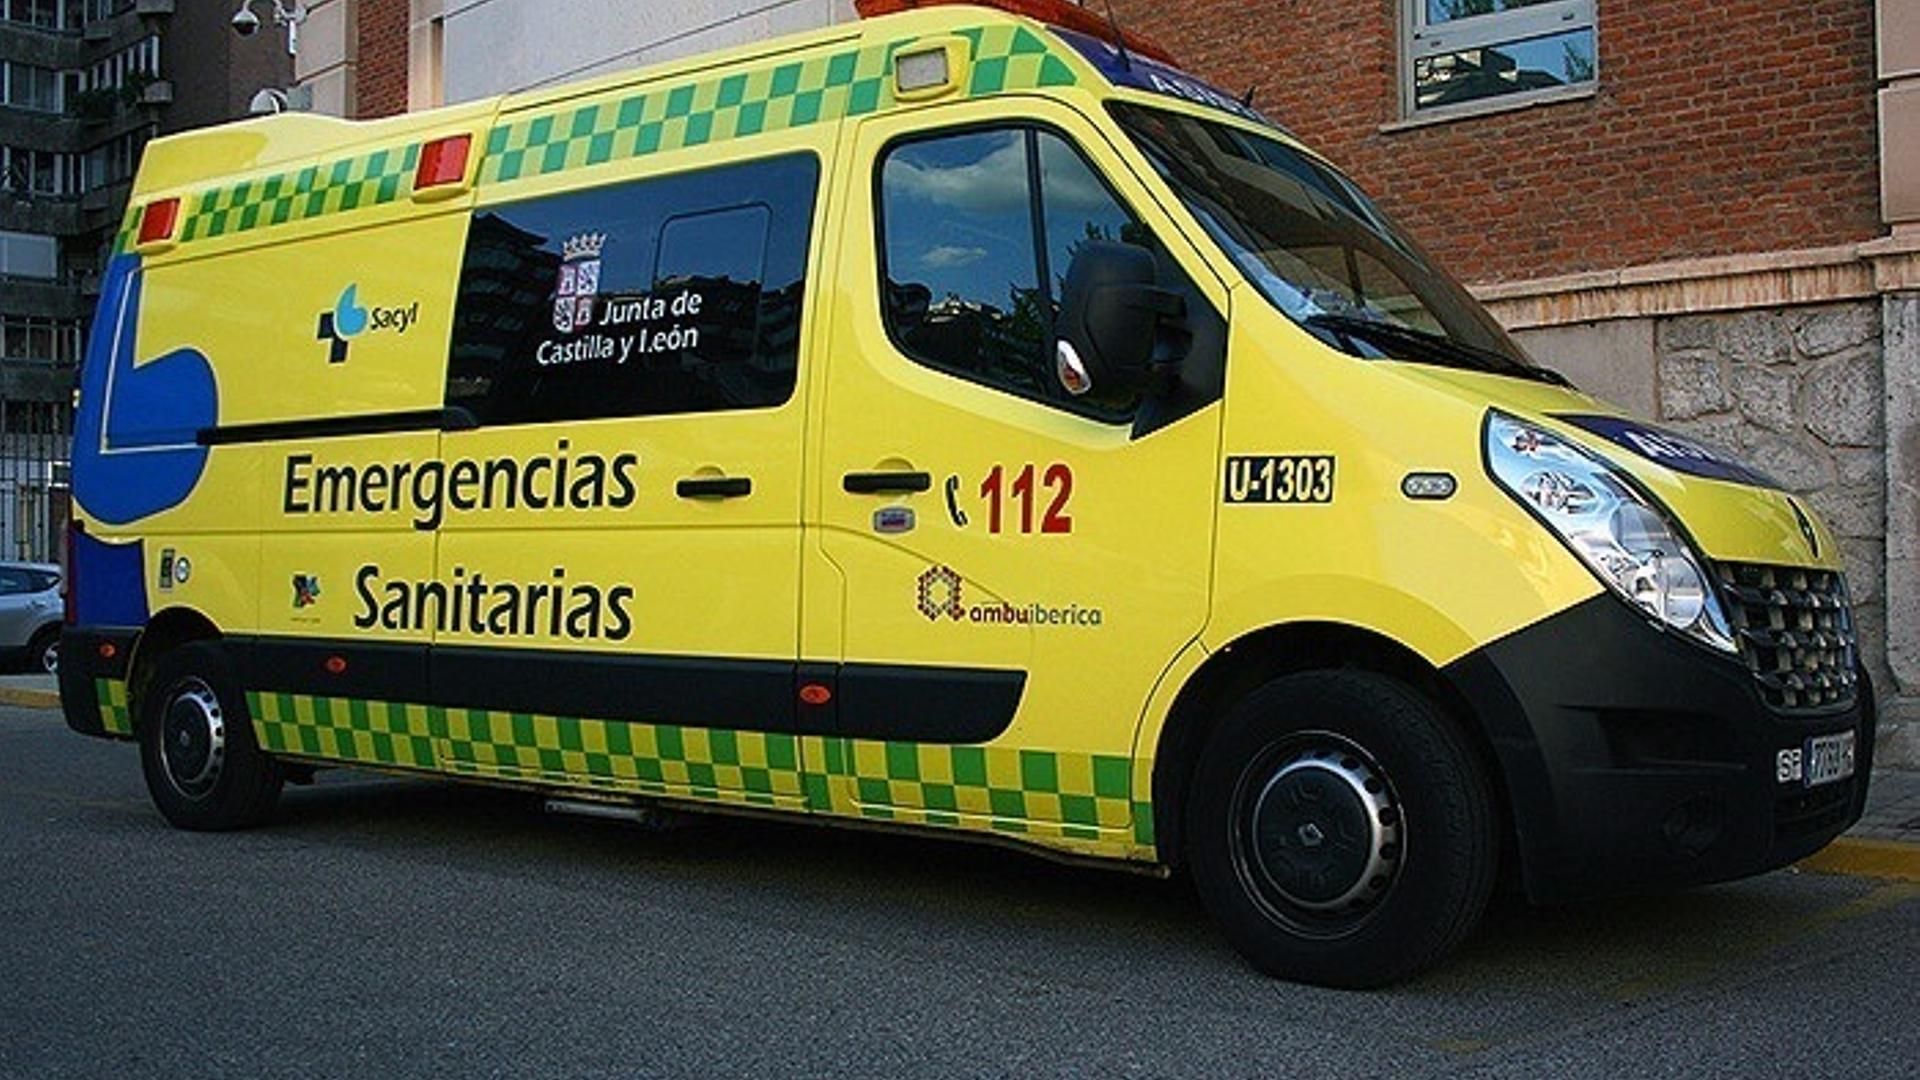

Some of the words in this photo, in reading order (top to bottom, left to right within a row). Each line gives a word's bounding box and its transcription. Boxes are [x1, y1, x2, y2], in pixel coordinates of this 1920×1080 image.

[371, 302, 418, 333] Sacyl
[599, 297, 666, 325] Junta
[671, 290, 702, 316] de
[536, 334, 615, 365] Castilla
[618, 335, 634, 364] y
[639, 324, 699, 354] León
[284, 439, 638, 531] Emergencias
[980, 464, 1073, 534] 112
[1230, 458, 1331, 501] U-1303
[354, 565, 634, 641] Sanitarias
[969, 602, 1103, 625] ambuiberica
